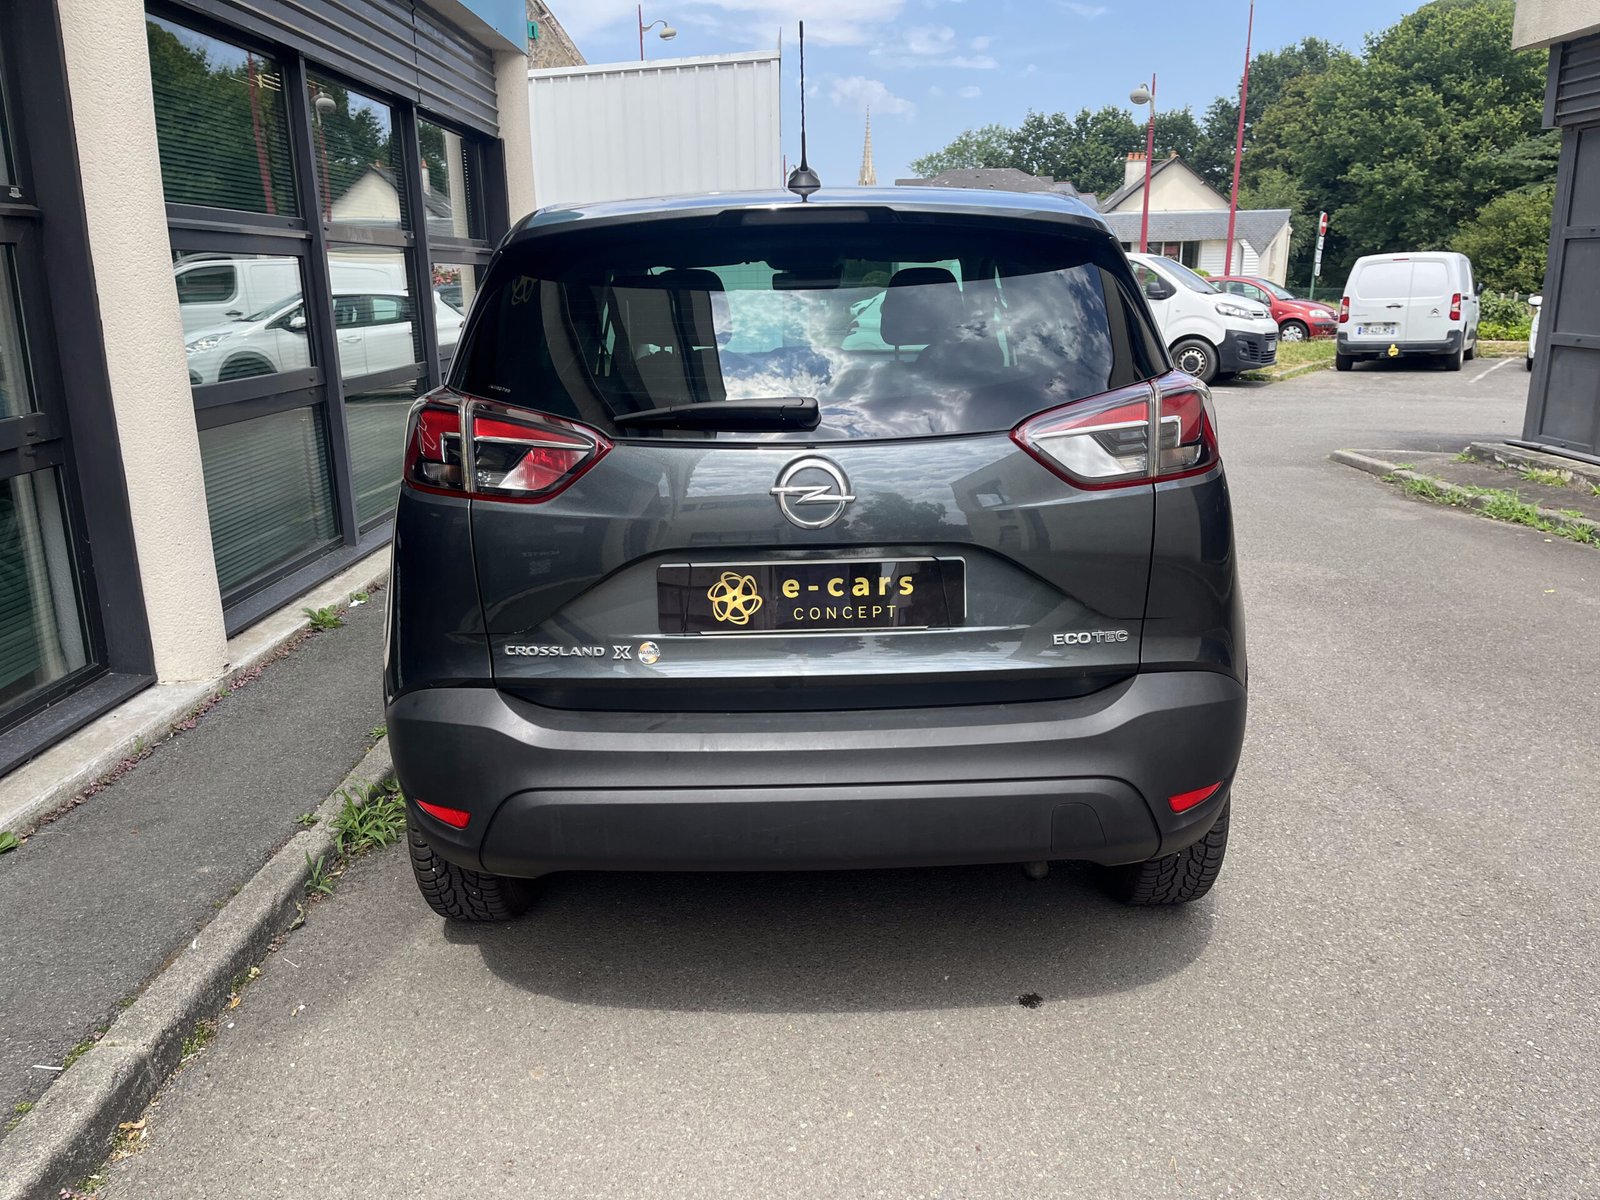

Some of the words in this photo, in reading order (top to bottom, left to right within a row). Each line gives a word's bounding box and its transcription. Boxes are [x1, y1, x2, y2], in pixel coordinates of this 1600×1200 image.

[782, 574, 914, 598] e-cars
[793, 605, 897, 621] CONCEPT
[1053, 629, 1128, 645] ECOTEC
[504, 643, 605, 658] CROSSLAND
[612, 644, 632, 661] X
